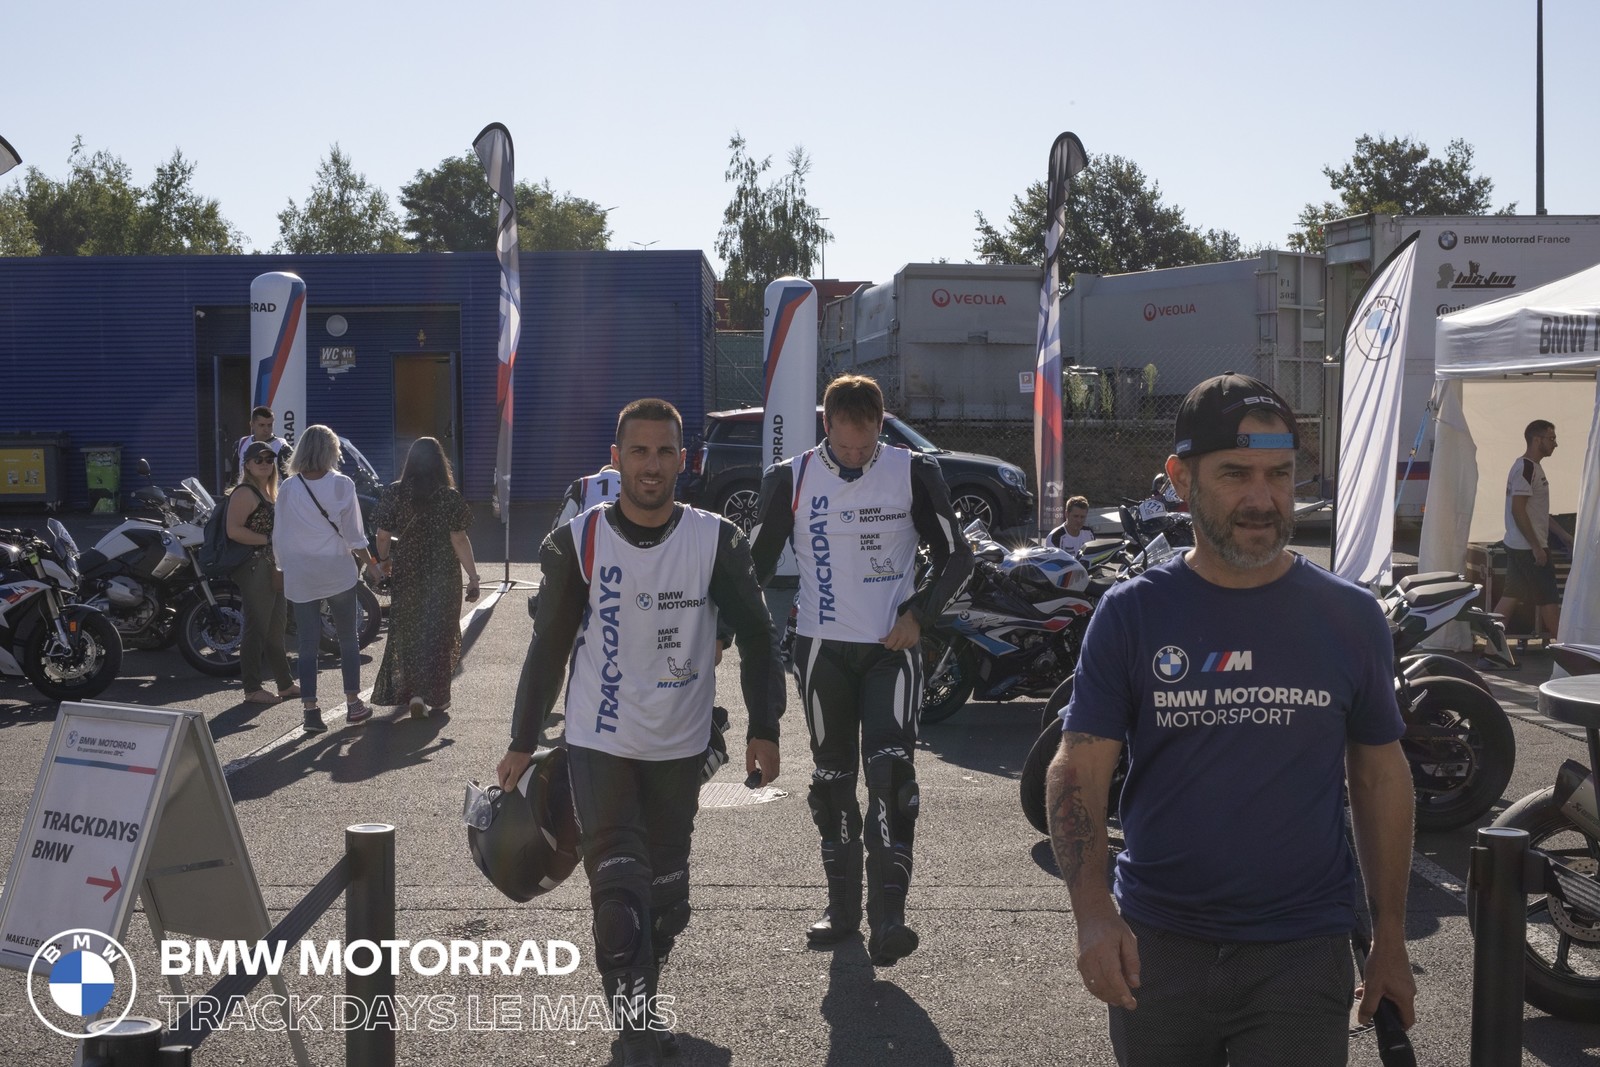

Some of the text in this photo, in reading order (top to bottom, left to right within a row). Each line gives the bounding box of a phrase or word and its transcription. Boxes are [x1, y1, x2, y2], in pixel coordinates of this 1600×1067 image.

[1464, 235, 1570, 244] BMW Motorrad France
[953, 294, 1006, 305] VEOLIA
[1158, 303, 1196, 316] VEOLIA
[1540, 314, 1588, 354] BMW
[322, 347, 340, 360] WC
[859, 512, 907, 523] MOTORRAD
[809, 496, 836, 625] TRACKDAYS
[863, 573, 904, 583] MICHELIN
[658, 591, 684, 601] BMW
[658, 628, 679, 636] MAKE
[595, 565, 623, 734] TRACKDAYS
[1153, 687, 1331, 707] BMW MOTORRAD
[1156, 707, 1295, 728] MOTORSPORT
[79, 736, 136, 750] BMW MOTORRAD
[42, 810, 139, 842] TRACKDAYS
[32, 840, 74, 863] BMW
[6, 934, 24, 945] MAKE
[25, 938, 40, 948] LIFE
